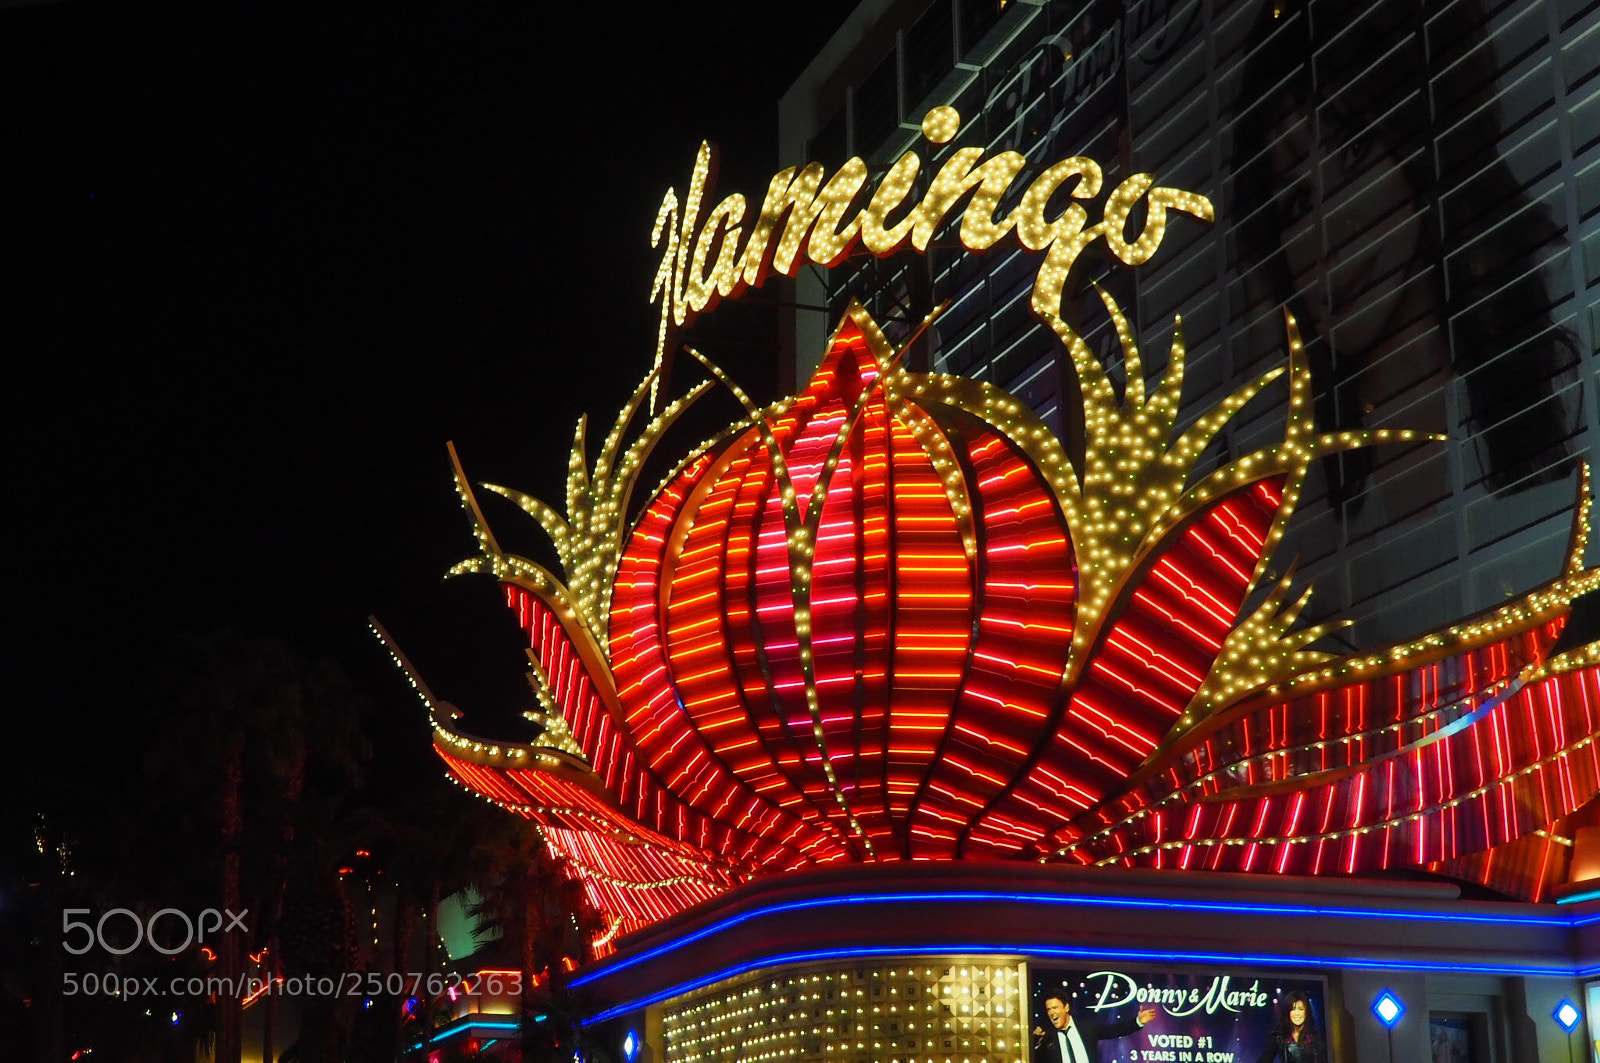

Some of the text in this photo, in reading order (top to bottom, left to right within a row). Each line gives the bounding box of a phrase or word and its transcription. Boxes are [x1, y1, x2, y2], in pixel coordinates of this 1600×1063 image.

[1085, 971, 1268, 1017] Donny & Marie
[1147, 1034, 1213, 1049] VOTED #1
[1130, 1049, 1235, 1063] 3 YEARS IN A ROW
